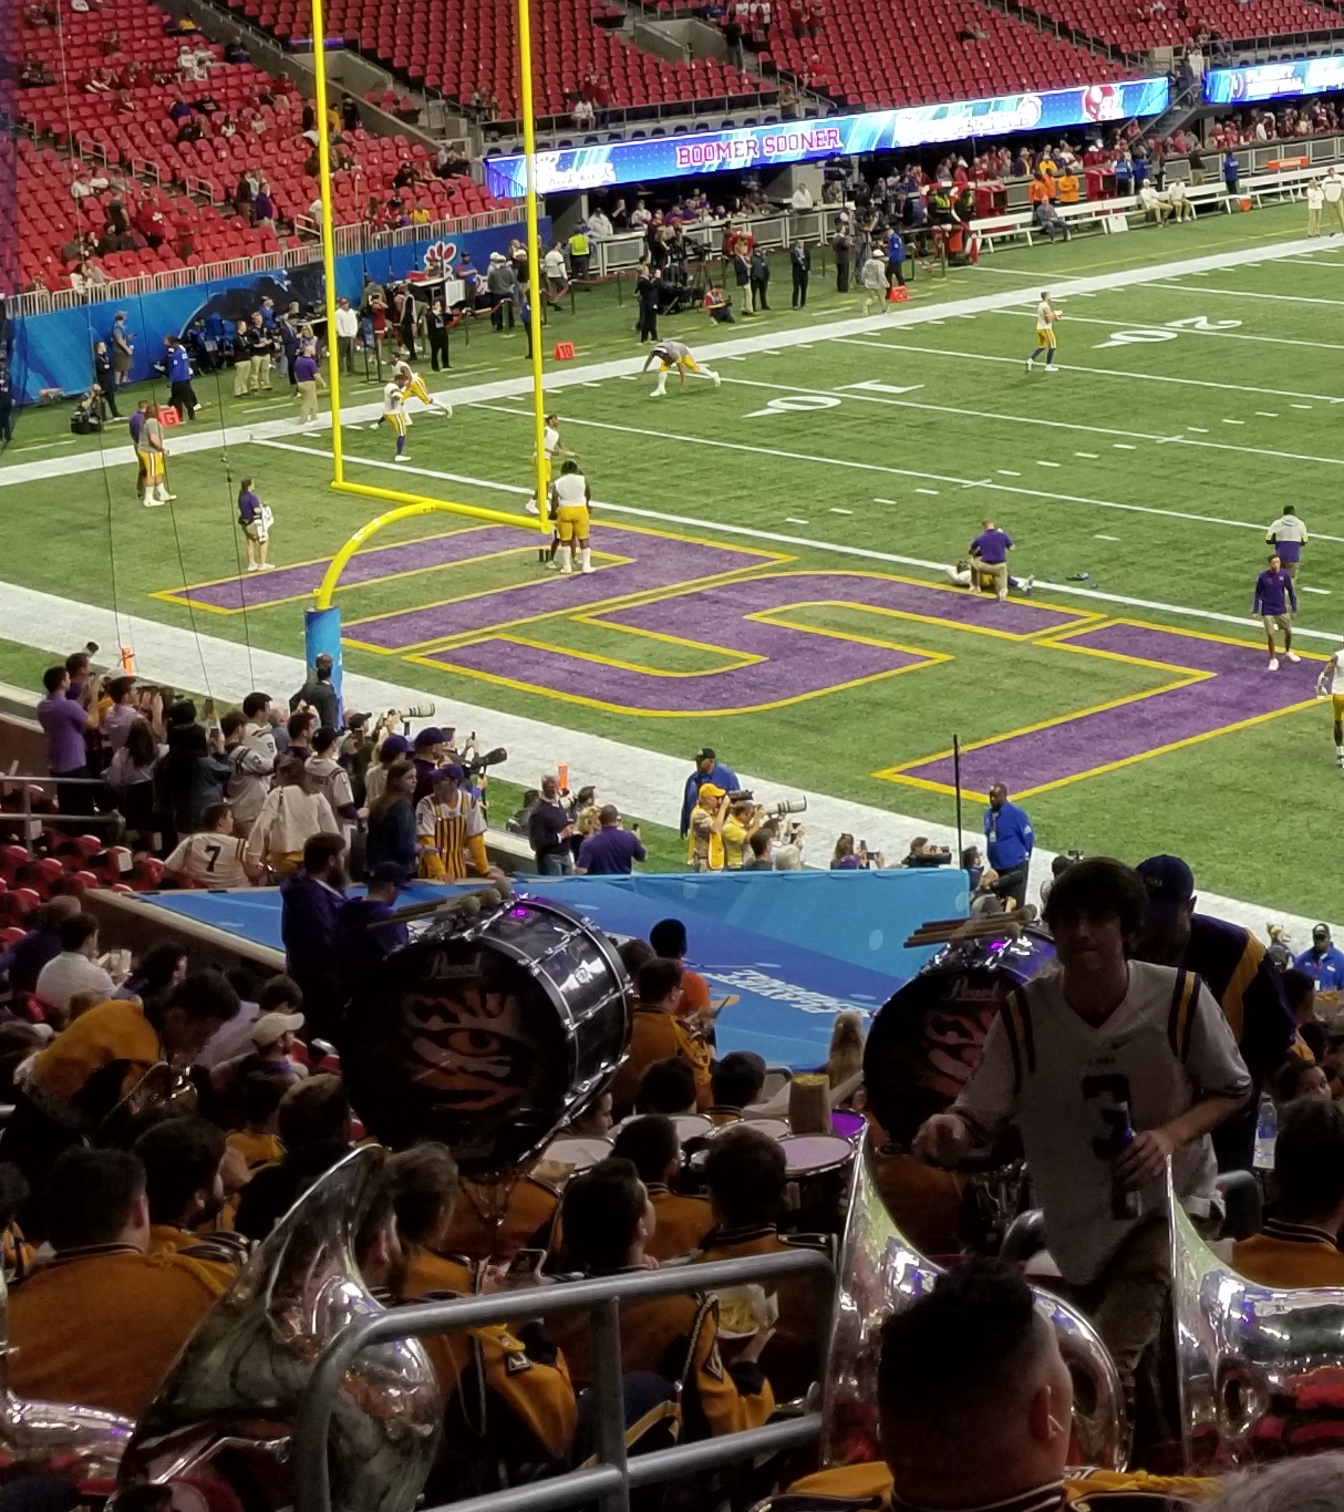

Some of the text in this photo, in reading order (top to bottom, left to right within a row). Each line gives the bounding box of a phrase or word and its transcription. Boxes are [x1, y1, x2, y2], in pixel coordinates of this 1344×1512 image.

[676, 128, 822, 168] BOOMER SOONER
[204, 845, 221, 873] 7
[427, 951, 483, 979] Pearl
